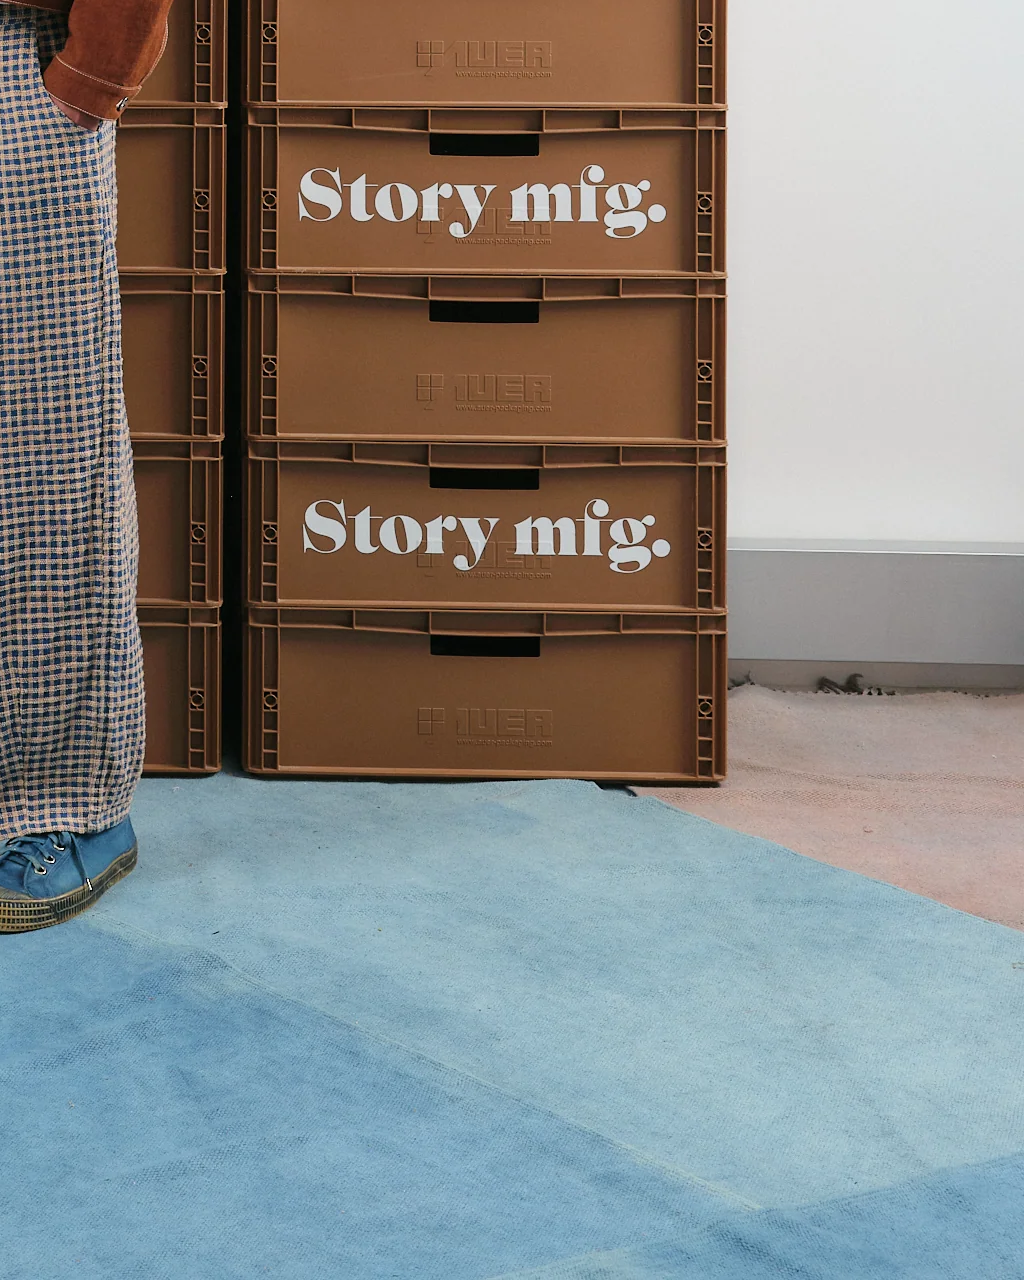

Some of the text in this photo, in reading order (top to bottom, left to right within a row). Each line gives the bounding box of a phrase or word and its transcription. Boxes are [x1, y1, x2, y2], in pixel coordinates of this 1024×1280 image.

[298, 164, 667, 239] Story mfg.
[301, 498, 671, 573] Story mfg.
